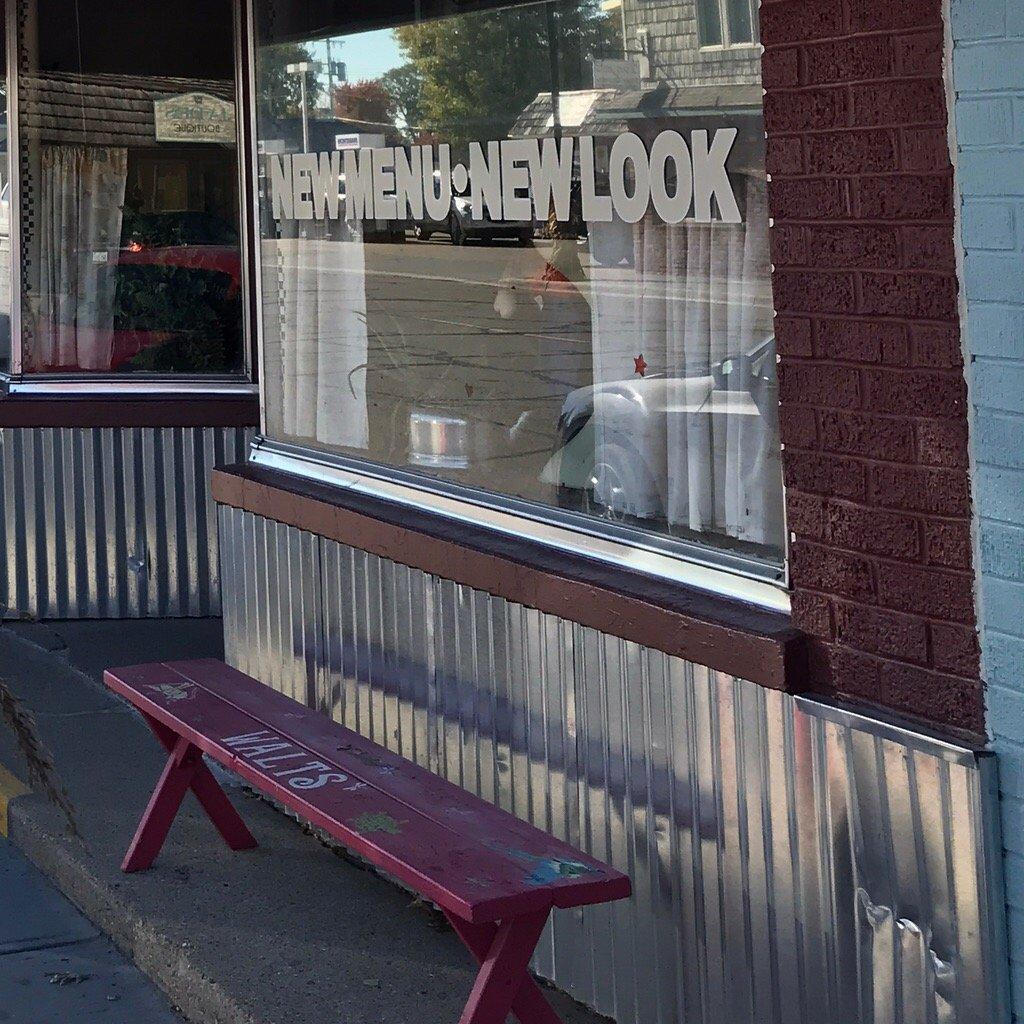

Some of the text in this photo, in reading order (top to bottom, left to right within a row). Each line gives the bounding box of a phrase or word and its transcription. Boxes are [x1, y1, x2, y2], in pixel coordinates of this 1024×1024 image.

[271, 127, 742, 224] NEW MENU NEW LOOK
